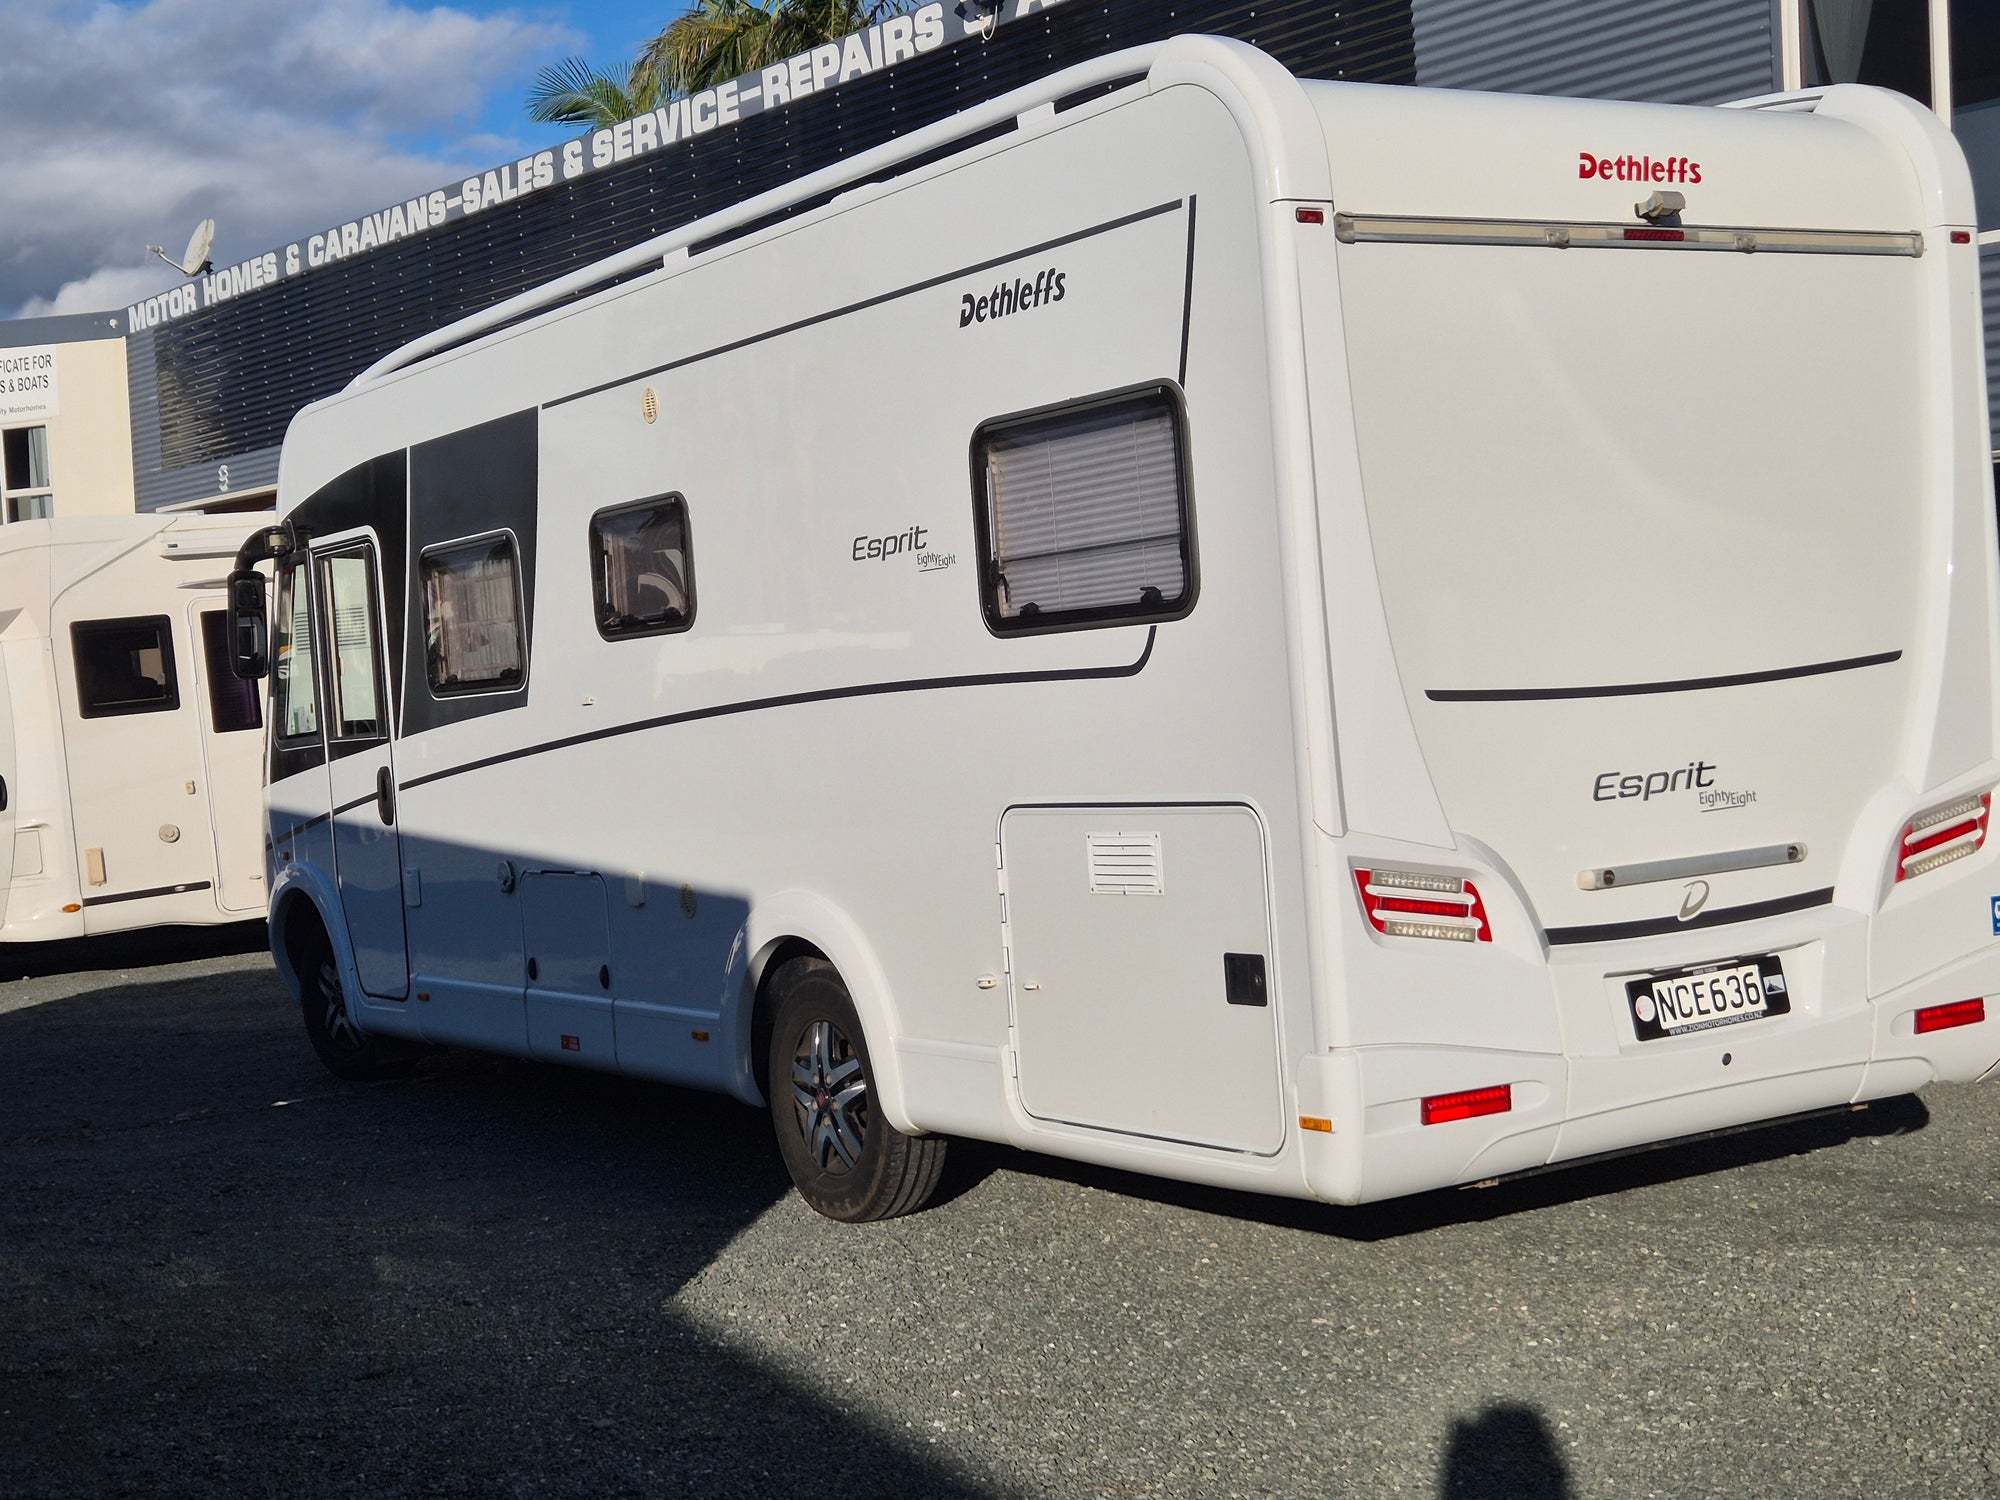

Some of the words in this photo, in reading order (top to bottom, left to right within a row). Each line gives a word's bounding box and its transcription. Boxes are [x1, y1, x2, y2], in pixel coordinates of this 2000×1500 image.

[1578, 152, 1702, 184] Dethleffs
[127, 283, 197, 334] MOTOR
[202, 251, 277, 306] HOMES
[285, 242, 300, 276] &
[562, 140, 584, 180] &
[959, 267, 1066, 328] Dethleffs
[32, 354, 52, 370] FOR
[8, 378, 15, 393] &
[17, 374, 49, 392] BOATS
[852, 525, 928, 562] Esprit
[1592, 760, 1717, 802] Esprit
[1655, 971, 1761, 1023] NCE636
[1668, 1010, 1764, 1036] WWW.ZIONMOTORHOMES.CO.NZ
